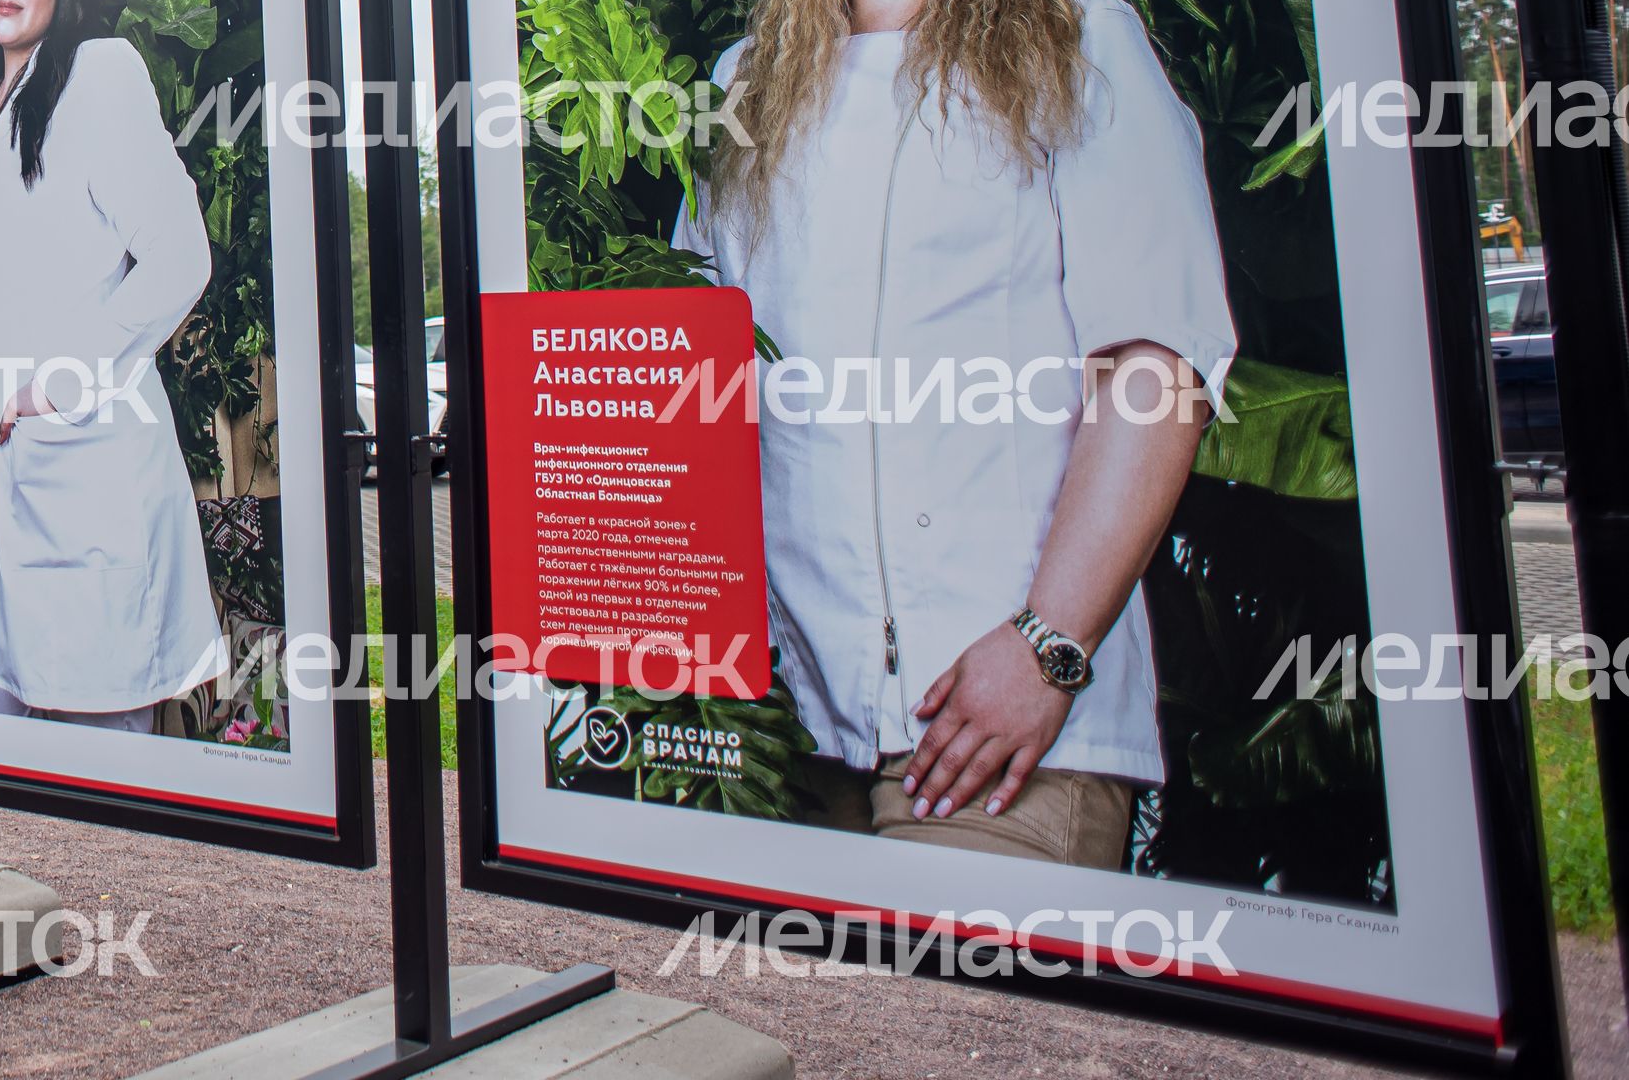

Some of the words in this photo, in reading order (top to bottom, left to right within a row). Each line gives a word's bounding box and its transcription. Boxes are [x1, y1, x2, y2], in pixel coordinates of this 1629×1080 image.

[532, 327, 691, 352] БЕЛЯКОВА
[533, 361, 683, 385] Анастасия
[534, 393, 655, 418] Львовна
[534, 442, 649, 457] Врач-инфекционист
[535, 456, 623, 473] инфекционного
[626, 462, 688, 474] отделения
[535, 472, 563, 484] ГБУЗ
[565, 473, 583, 485] МО
[586, 473, 671, 489] «Одинцовская
[536, 487, 595, 501] Областная
[598, 489, 662, 505] Больница»
[537, 512, 586, 526] Работает
[589, 517, 595, 526] в
[598, 514, 650, 530] «красной
[654, 520, 687, 531] зоне»
[690, 521, 696, 531] с
[537, 530, 569, 542] марта
[572, 529, 599, 542] 2020
[602, 533, 631, 544] года,
[634, 534, 689, 546] отмечена
[538, 545, 655, 562] правительственными
[659, 552, 726, 566] наградами.
[539, 557, 588, 572] Работает
[590, 562, 596, 572] с
[599, 560, 655, 576] тяжёлыми
[659, 564, 718, 580] больными
[721, 571, 744, 582] при
[539, 575, 600, 589] поражении
[603, 577, 641, 591] лёгких
[644, 579, 669, 593] 90%
[672, 583, 679, 593] и
[683, 582, 720, 597] более,
[539, 588, 573, 603] одной
[576, 593, 588, 603] из
[591, 594, 632, 607] первых
[636, 597, 642, 607] в
[645, 597, 706, 612] отделении
[540, 604, 610, 620] участвовала
[612, 610, 619, 620] в
[622, 608, 688, 626] разработке
[642, 722, 741, 747] СПАСИБО
[642, 739, 742, 767] ВРАЧАМ
[1226, 896, 1298, 918] Фотограф:
[1302, 908, 1332, 923] Гера
[1337, 915, 1400, 936] Скандал
